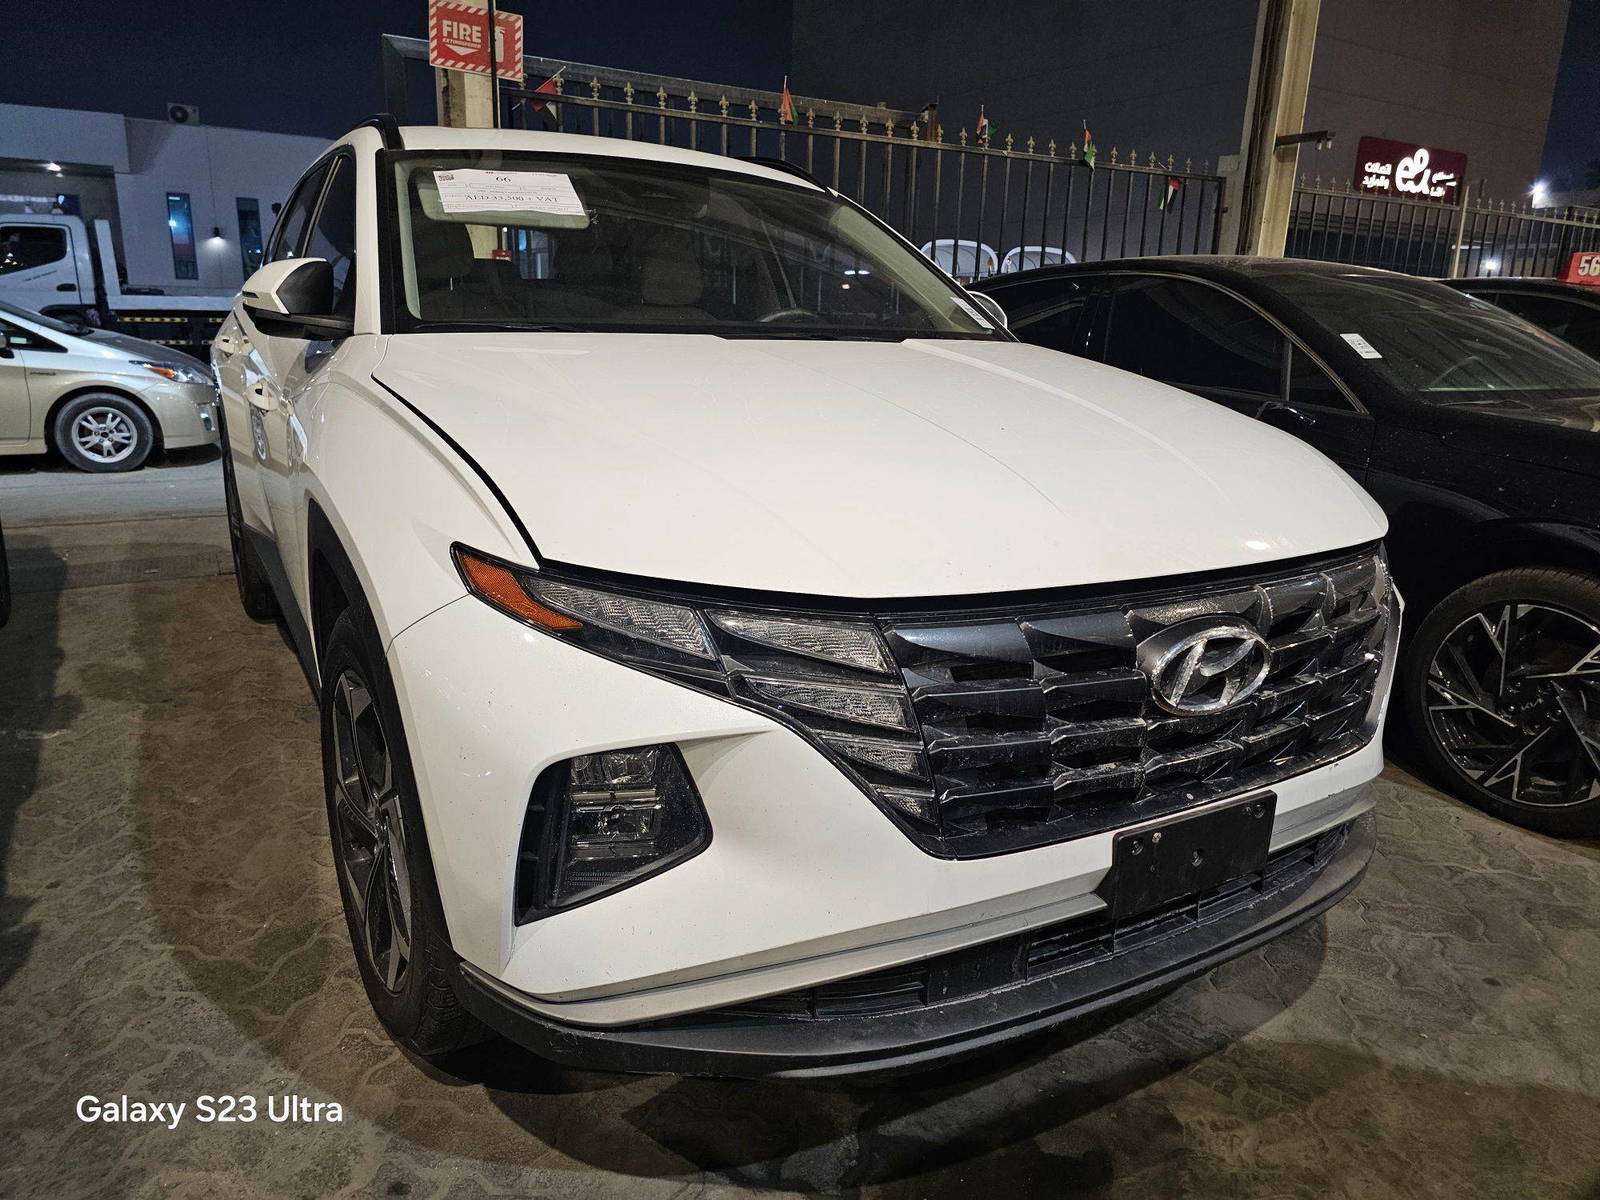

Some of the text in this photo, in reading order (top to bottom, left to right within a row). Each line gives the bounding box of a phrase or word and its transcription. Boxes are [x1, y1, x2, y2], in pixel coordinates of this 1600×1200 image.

[442, 19, 482, 43] FIRE
[495, 175, 512, 184] 66
[1578, 255, 1600, 276] 56
